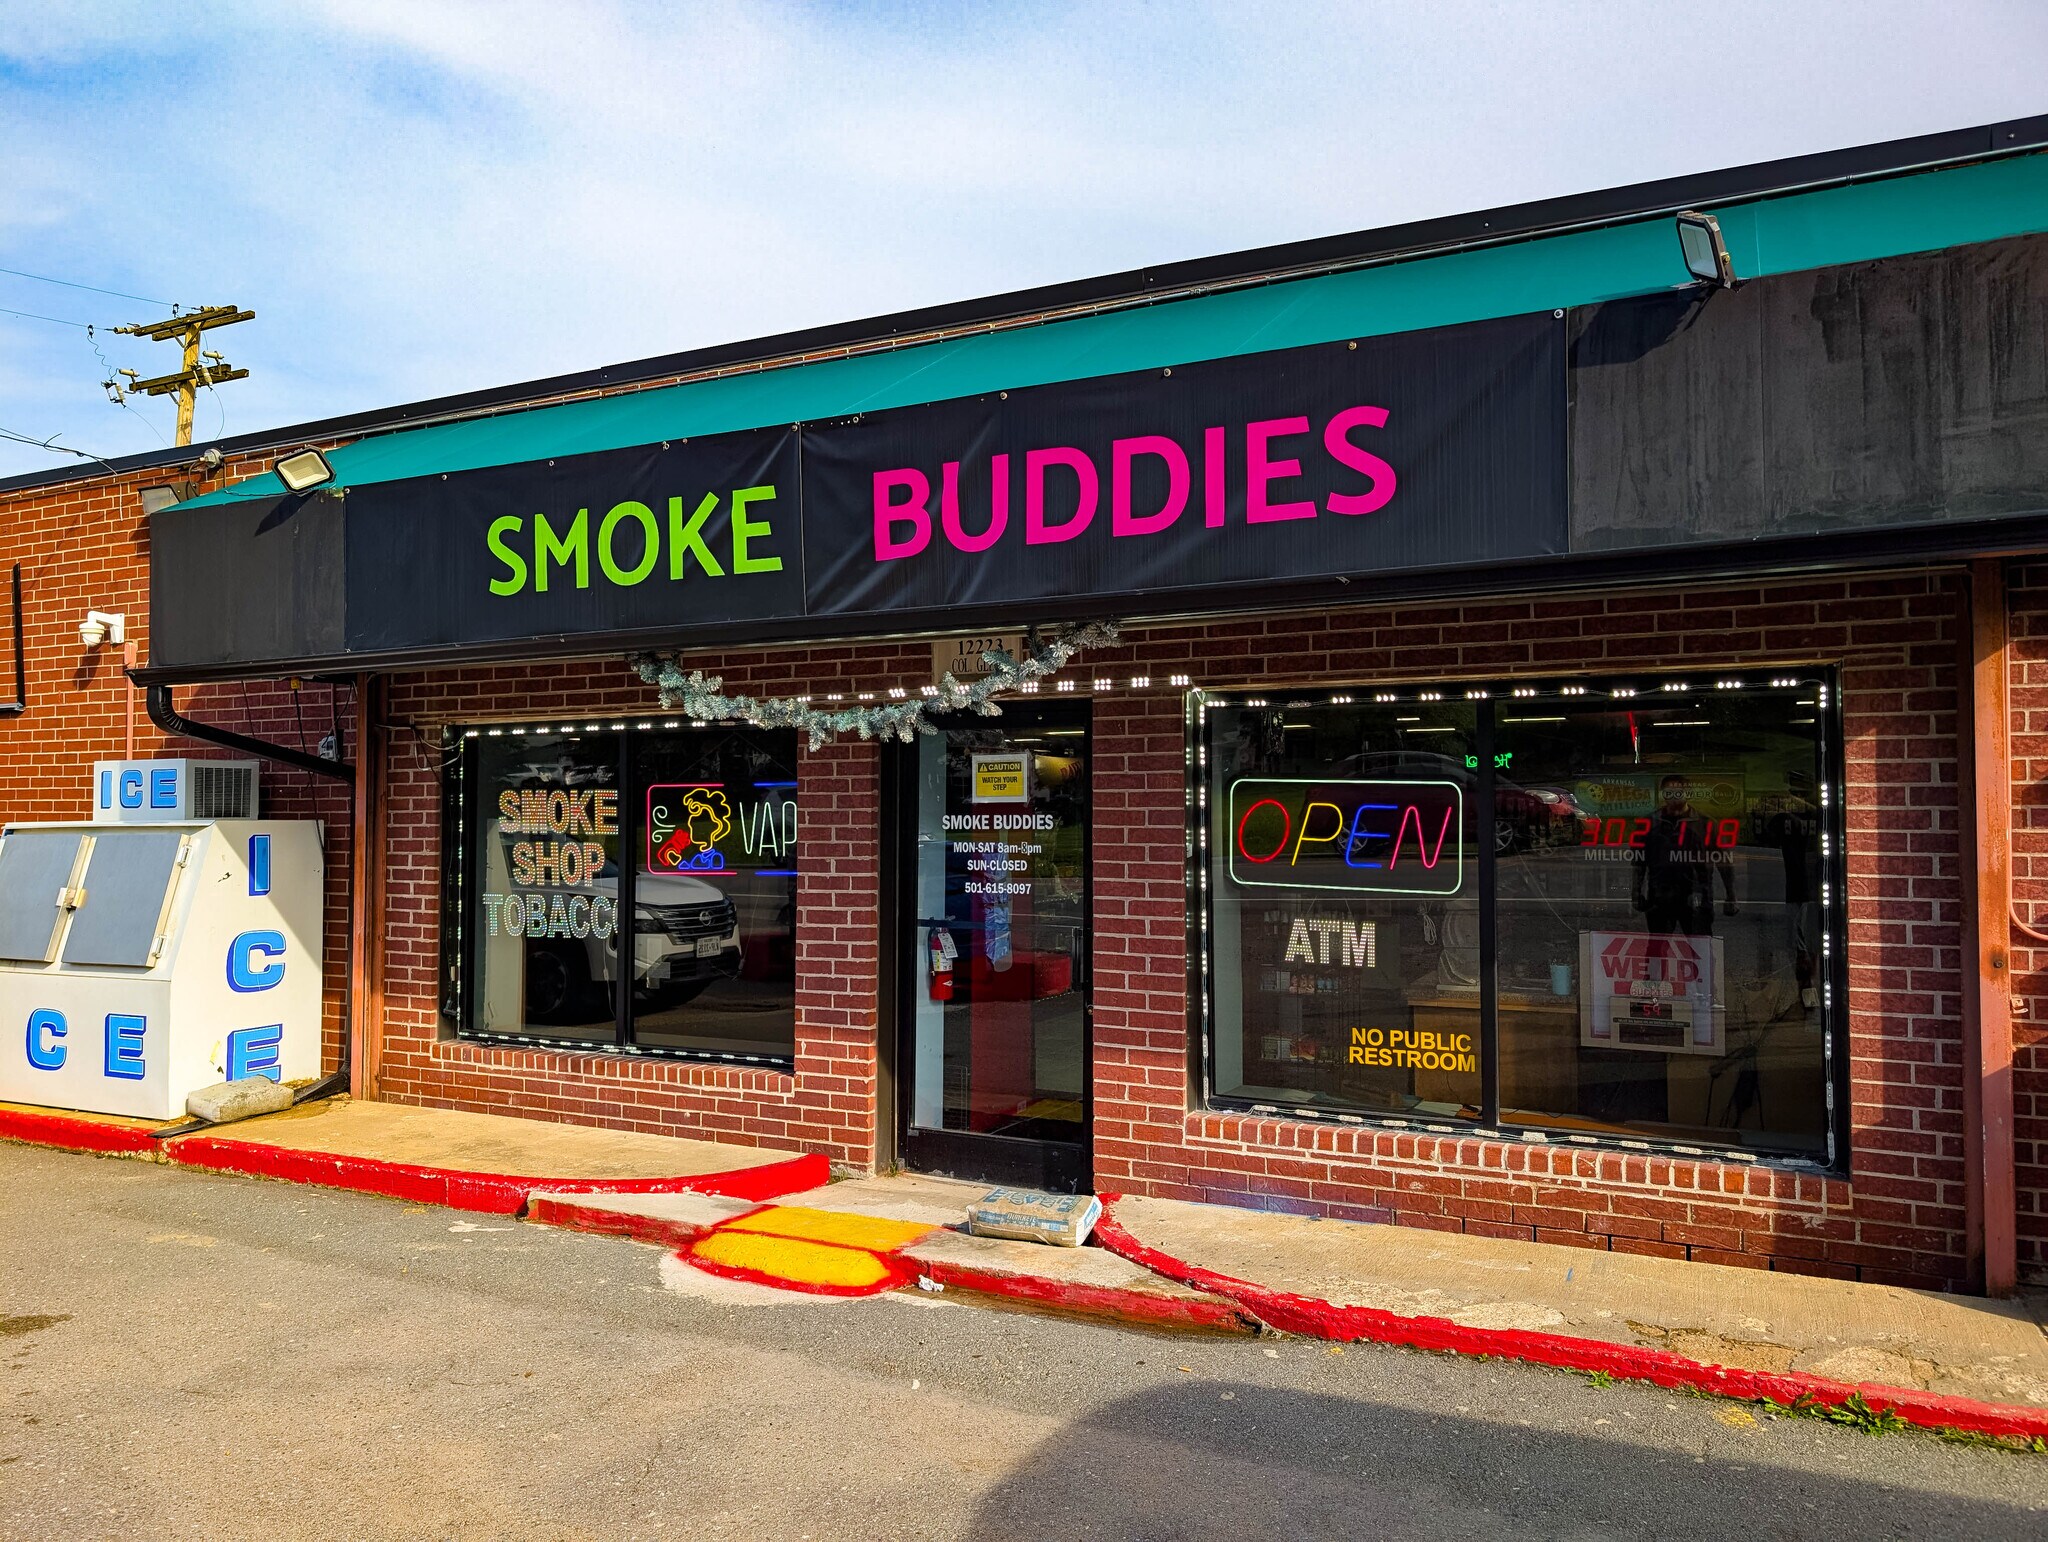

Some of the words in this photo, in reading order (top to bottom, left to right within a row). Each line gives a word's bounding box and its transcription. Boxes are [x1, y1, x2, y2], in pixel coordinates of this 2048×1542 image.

[486, 484, 783, 598] SMOKE
[872, 405, 1397, 562] BUDDIES
[988, 763, 1020, 771] CAUTION
[100, 768, 178, 809] ICE
[499, 789, 619, 835] SMOKE
[942, 814, 990, 830] SMOKE
[993, 814, 1054, 830] BUDDIES
[739, 800, 798, 857] VAP
[1238, 798, 1452, 871] OPEN
[1580, 817, 1652, 848] 302
[1677, 817, 1740, 849] 118
[953, 842, 995, 853] MON-SAT
[1584, 849, 1646, 861] MILLION
[1669, 850, 1734, 863] MILLION
[512, 841, 605, 887] SHOP
[967, 859, 1028, 871] SUN-CLOSED
[964, 882, 1032, 894] 501-615-8097
[482, 893, 619, 939] TOBACC
[226, 834, 285, 1082] ICE
[1285, 918, 1376, 967] ATM
[1600, 955, 1651, 981] WE
[26, 1008, 147, 1080] CE
[1351, 1027, 1384, 1046] NO
[1389, 1029, 1472, 1052] PUBLIC
[1349, 1046, 1476, 1072] RESTROOM
